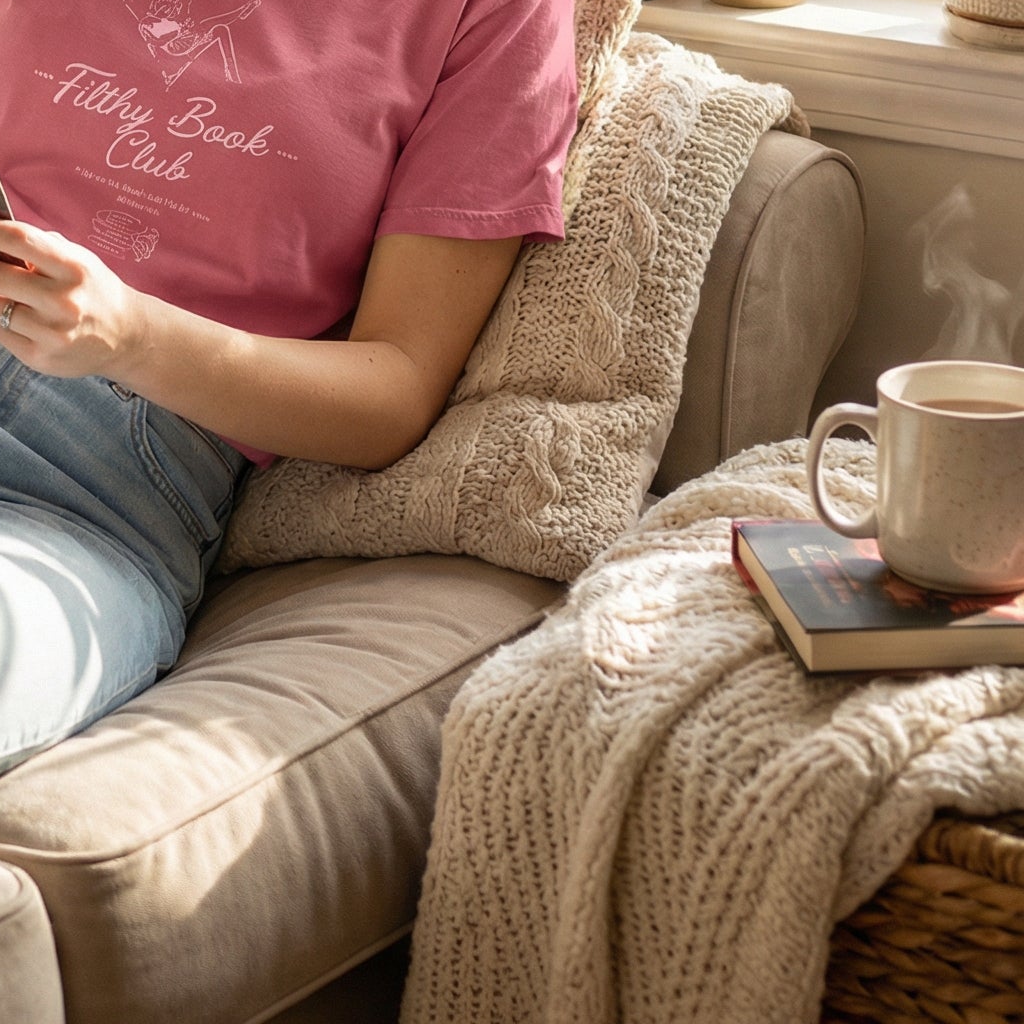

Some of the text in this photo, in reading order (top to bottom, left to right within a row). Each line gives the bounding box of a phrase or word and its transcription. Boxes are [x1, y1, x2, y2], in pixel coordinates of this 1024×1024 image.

[53, 62, 275, 157] Filthy Book
[105, 129, 194, 182] Club
